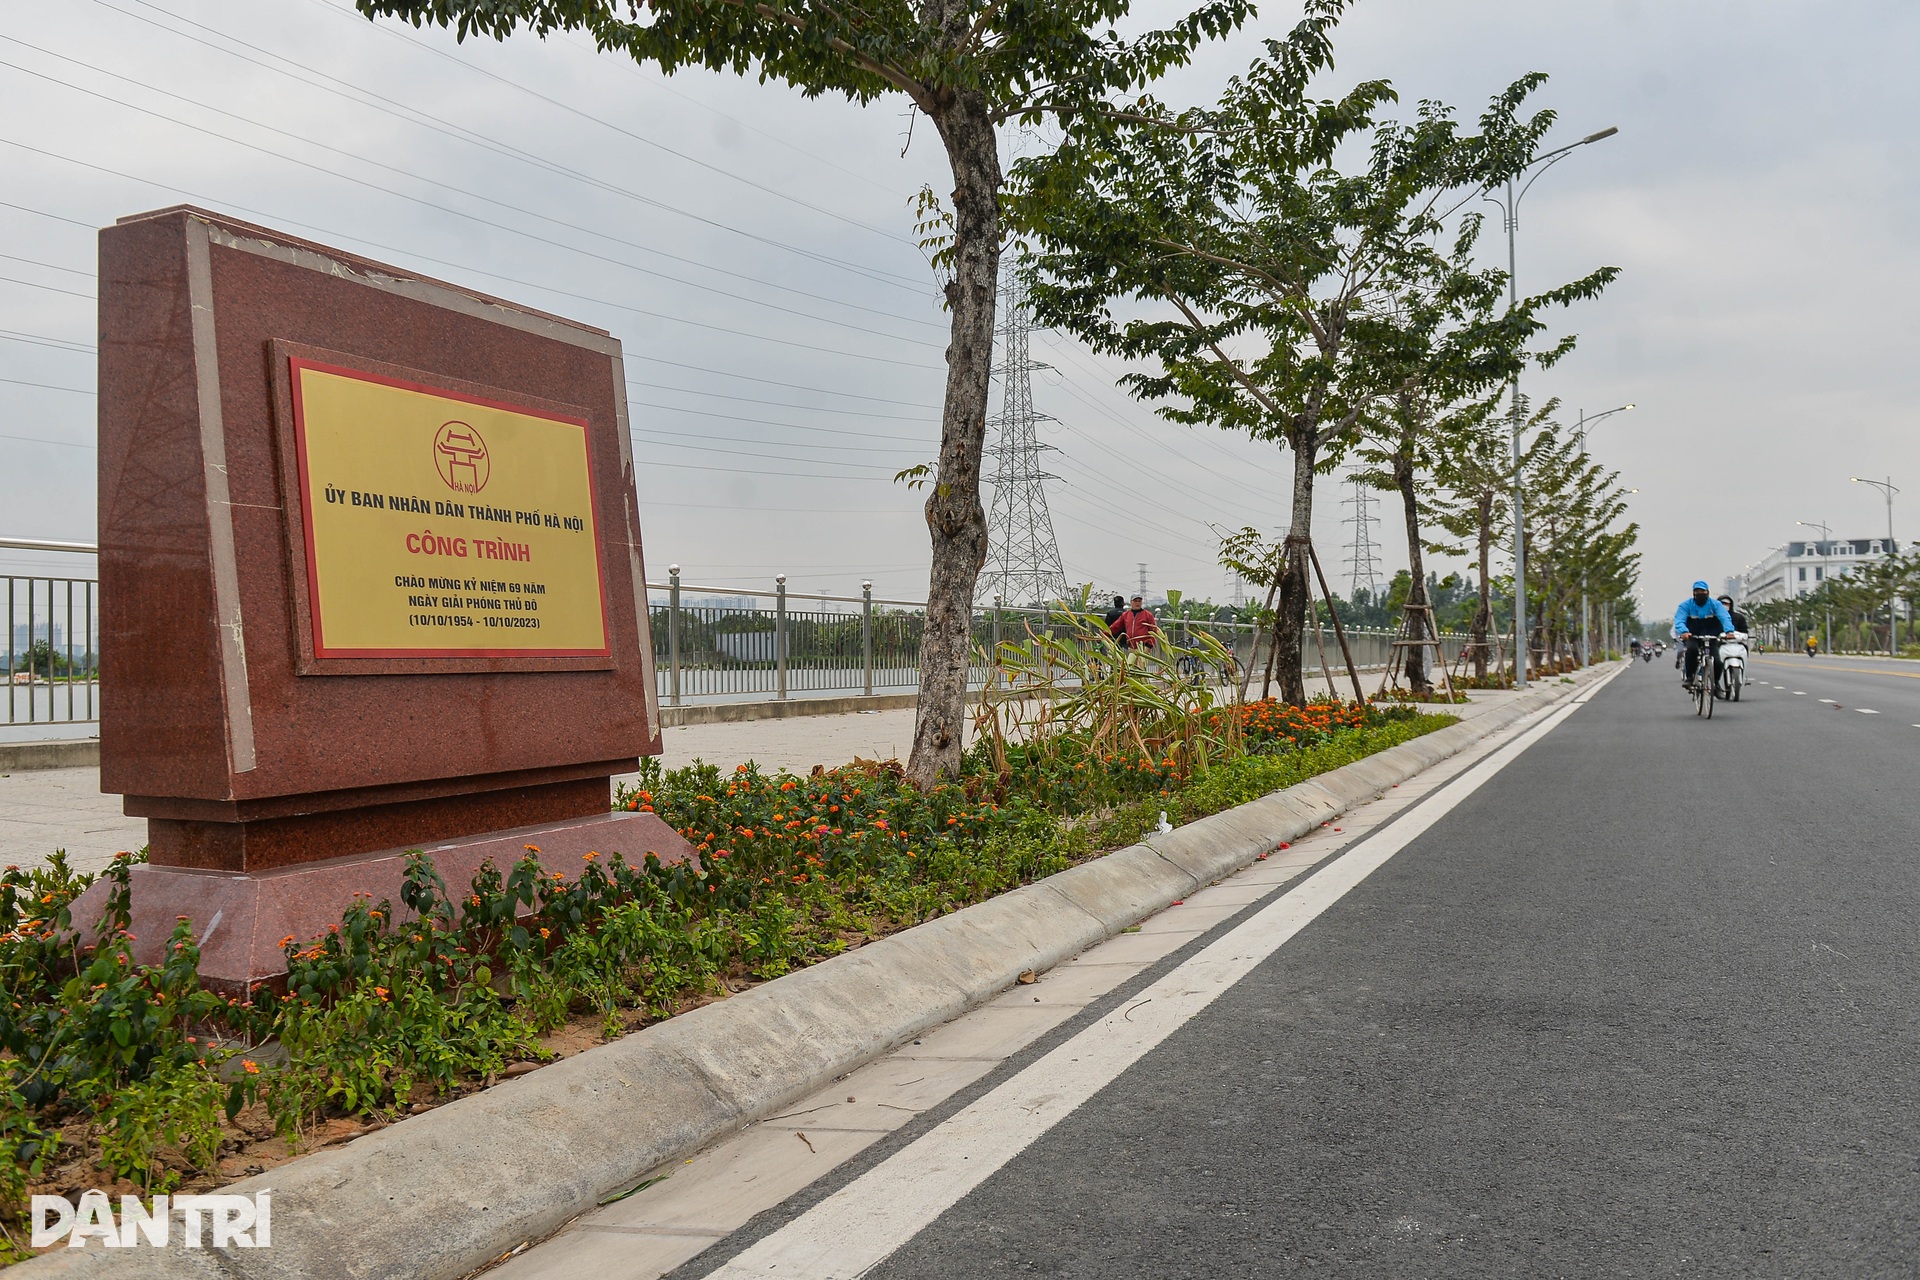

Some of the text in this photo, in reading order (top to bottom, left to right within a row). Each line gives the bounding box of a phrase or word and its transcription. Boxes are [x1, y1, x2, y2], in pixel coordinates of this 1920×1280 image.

[324, 483, 584, 533] ỦY BAN NHÂN DÂN THÀNH PHỐ HÀ NỘI
[406, 529, 531, 562] CÔNG TRÌNH
[395, 574, 546, 594] CHÀO MỪNG KỶ NIỆM 69 NĂM
[408, 593, 439, 608] NGÀY
[442, 593, 463, 608] GIẢI
[503, 596, 522, 611] THỦ
[524, 598, 538, 611] ĐÔ
[409, 614, 473, 627] (10/10/1954
[483, 616, 540, 629] 10/10/2023)
